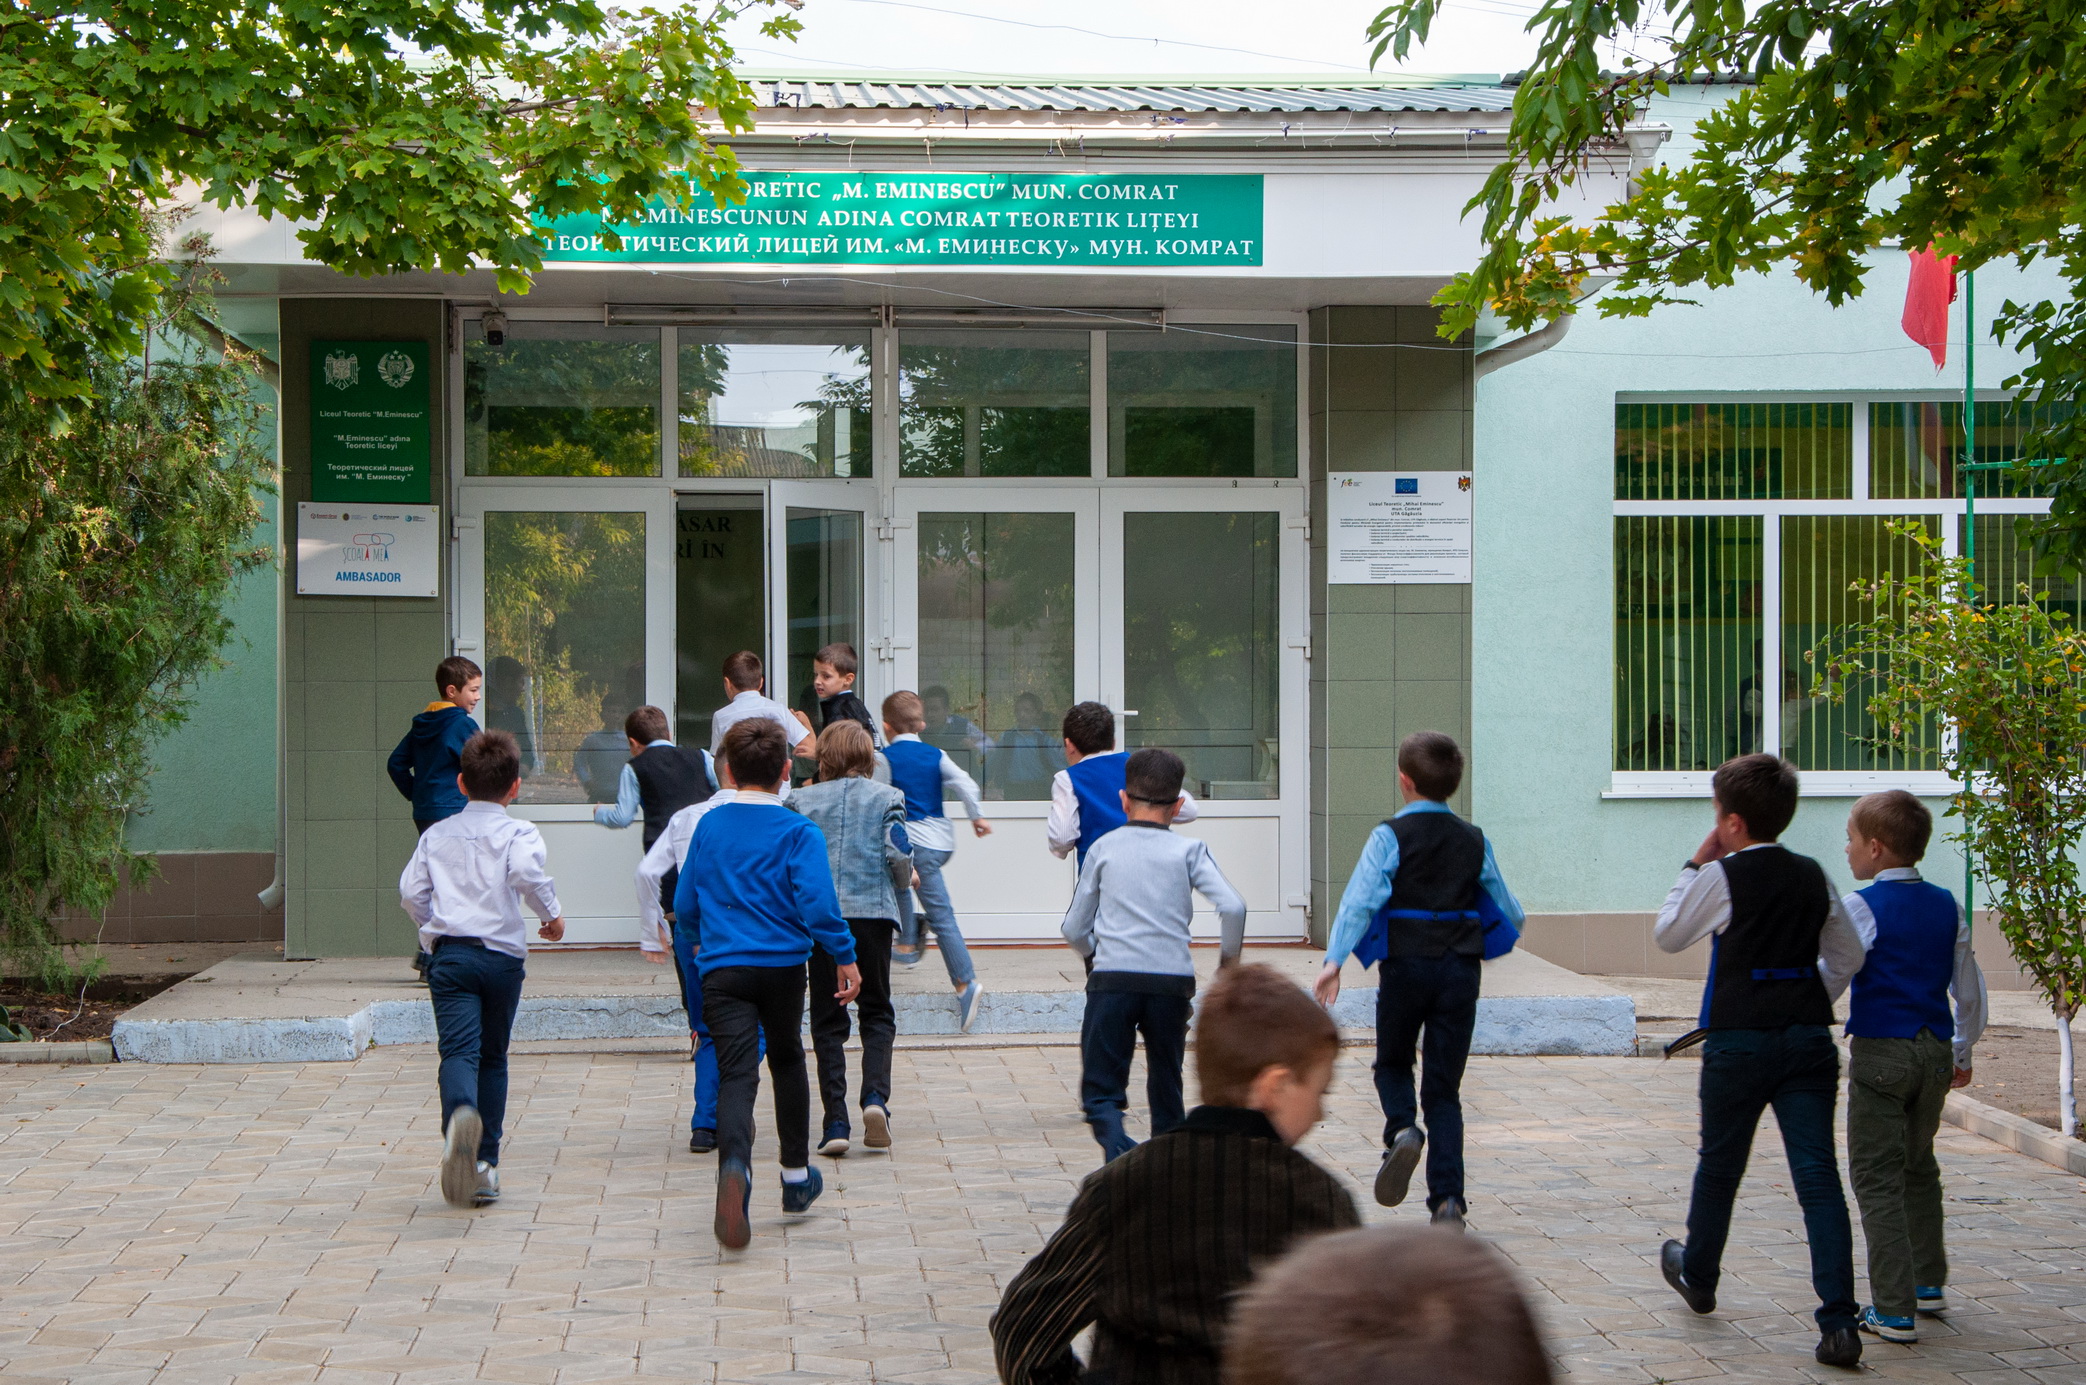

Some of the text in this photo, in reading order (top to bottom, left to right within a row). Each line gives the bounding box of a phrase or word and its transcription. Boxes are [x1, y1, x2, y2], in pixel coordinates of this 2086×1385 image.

[1013, 184, 1071, 199] MUN.
[1079, 184, 1178, 199] COMRAT
[817, 210, 894, 226] ADINA
[900, 211, 1000, 227] COMRAT
[1006, 212, 1119, 228] TEORETIK
[543, 233, 749, 252] ТЕОРТИЧЕСКИЙ
[757, 234, 838, 257] ЛИЦЕЙ
[846, 238, 889, 253] ИМ.
[895, 238, 931, 253] «М.
[1089, 240, 1149, 258] МУН.
[1155, 240, 1253, 255] КОМРАТ
[327, 463, 414, 472] Теоретический лицей
[335, 571, 402, 583] AMBASADOR
